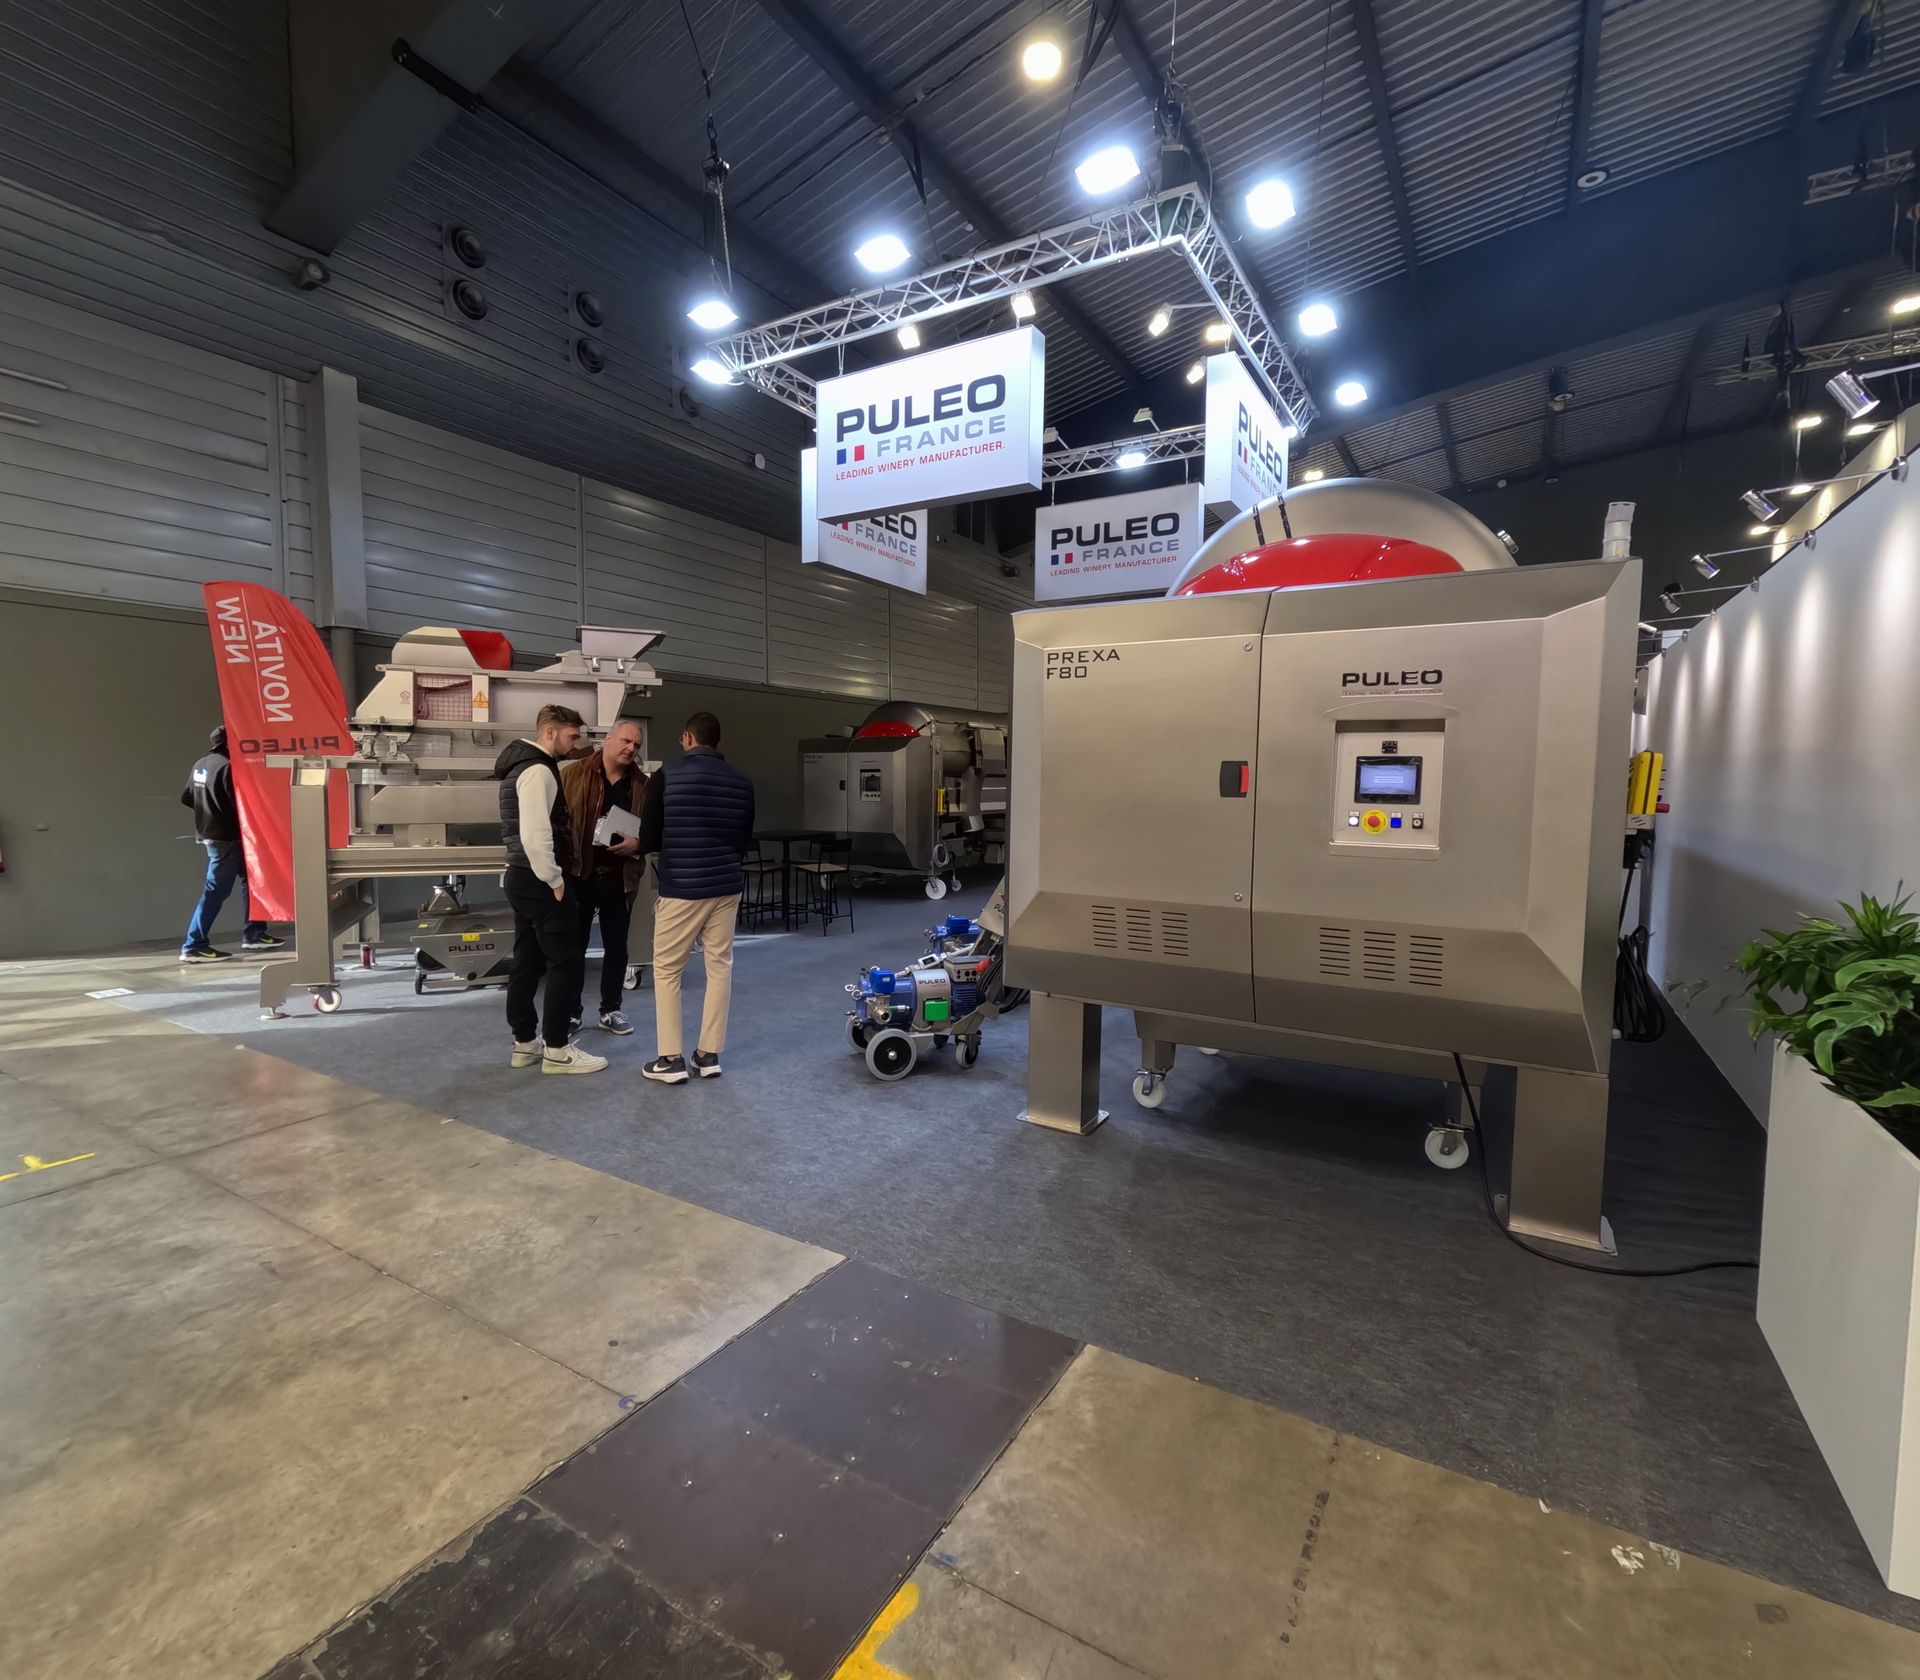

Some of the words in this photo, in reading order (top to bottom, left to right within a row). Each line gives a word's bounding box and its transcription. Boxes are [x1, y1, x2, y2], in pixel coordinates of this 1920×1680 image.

[836, 374, 1005, 442] PULEO
[876, 414, 1006, 457] FRANCE
[1238, 401, 1282, 484] PULEO
[836, 466, 874, 481] LEADING
[878, 457, 915, 473] WINERY
[1250, 455, 1282, 496] FRANC
[855, 522, 917, 557] FRANCE
[1051, 512, 1180, 551] PULEO
[1082, 538, 1180, 562] FRANCE
[1050, 567, 1080, 577] LEADING
[1083, 563, 1112, 573] WINERY
[1047, 648, 1120, 665] PREXA
[1046, 666, 1087, 679] F80
[1342, 669, 1443, 687] PULEO
[448, 943, 495, 953] PULEO
